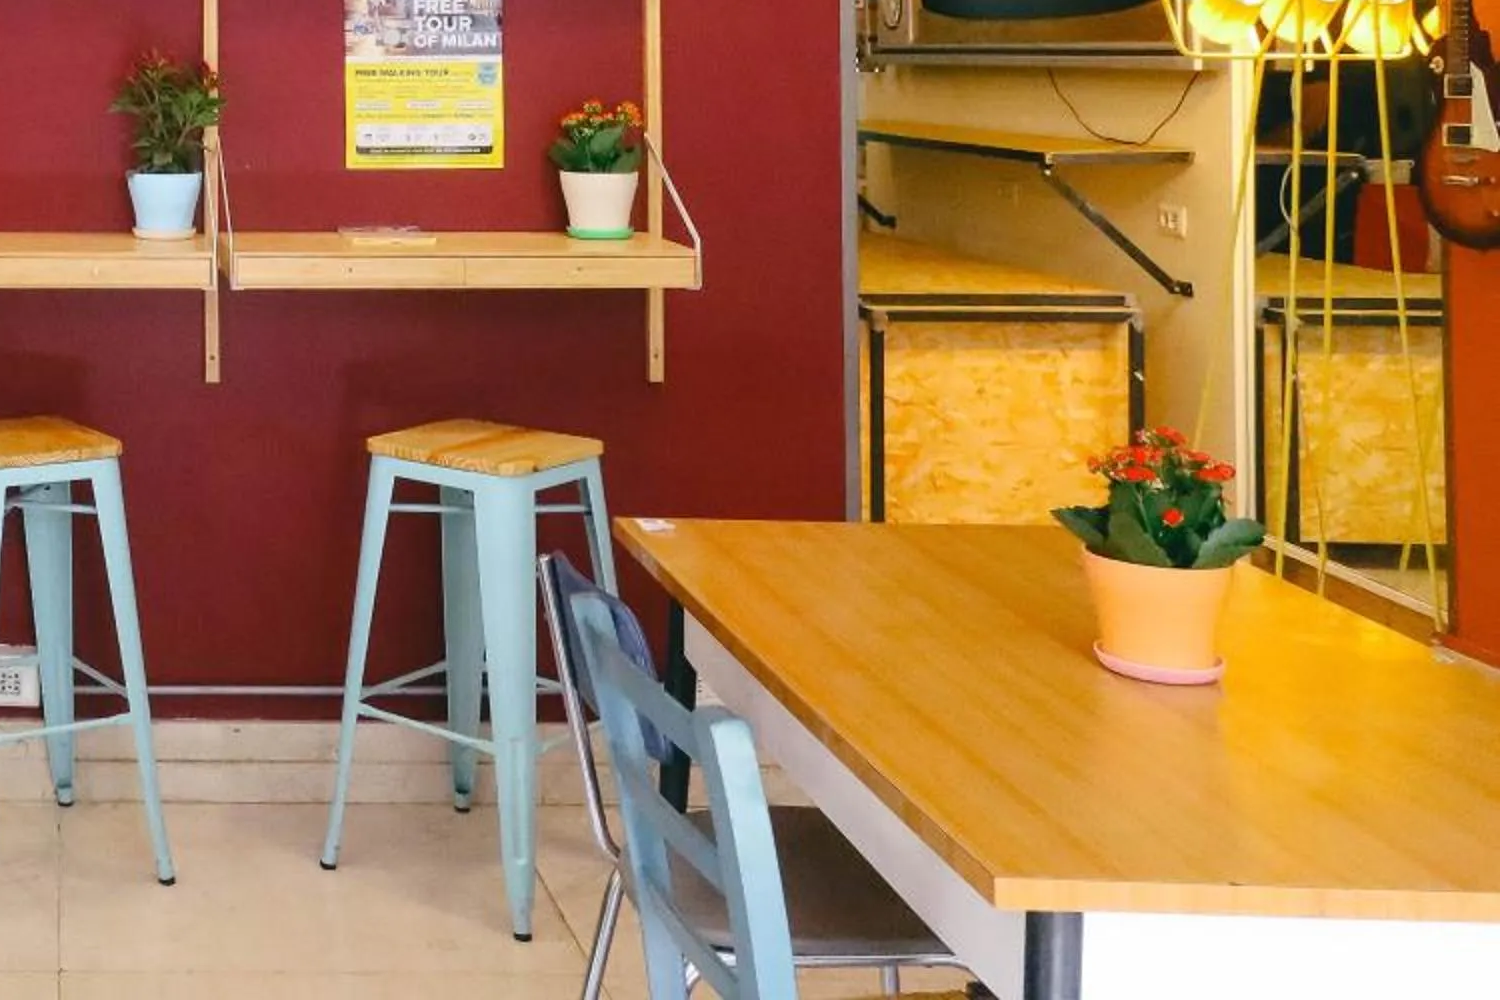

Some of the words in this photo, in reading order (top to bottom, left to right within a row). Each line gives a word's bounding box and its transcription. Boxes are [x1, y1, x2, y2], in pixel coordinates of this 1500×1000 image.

[414, 15, 473, 32] TOUR
[413, 34, 438, 48] OF
[441, 33, 497, 48] MILAN
